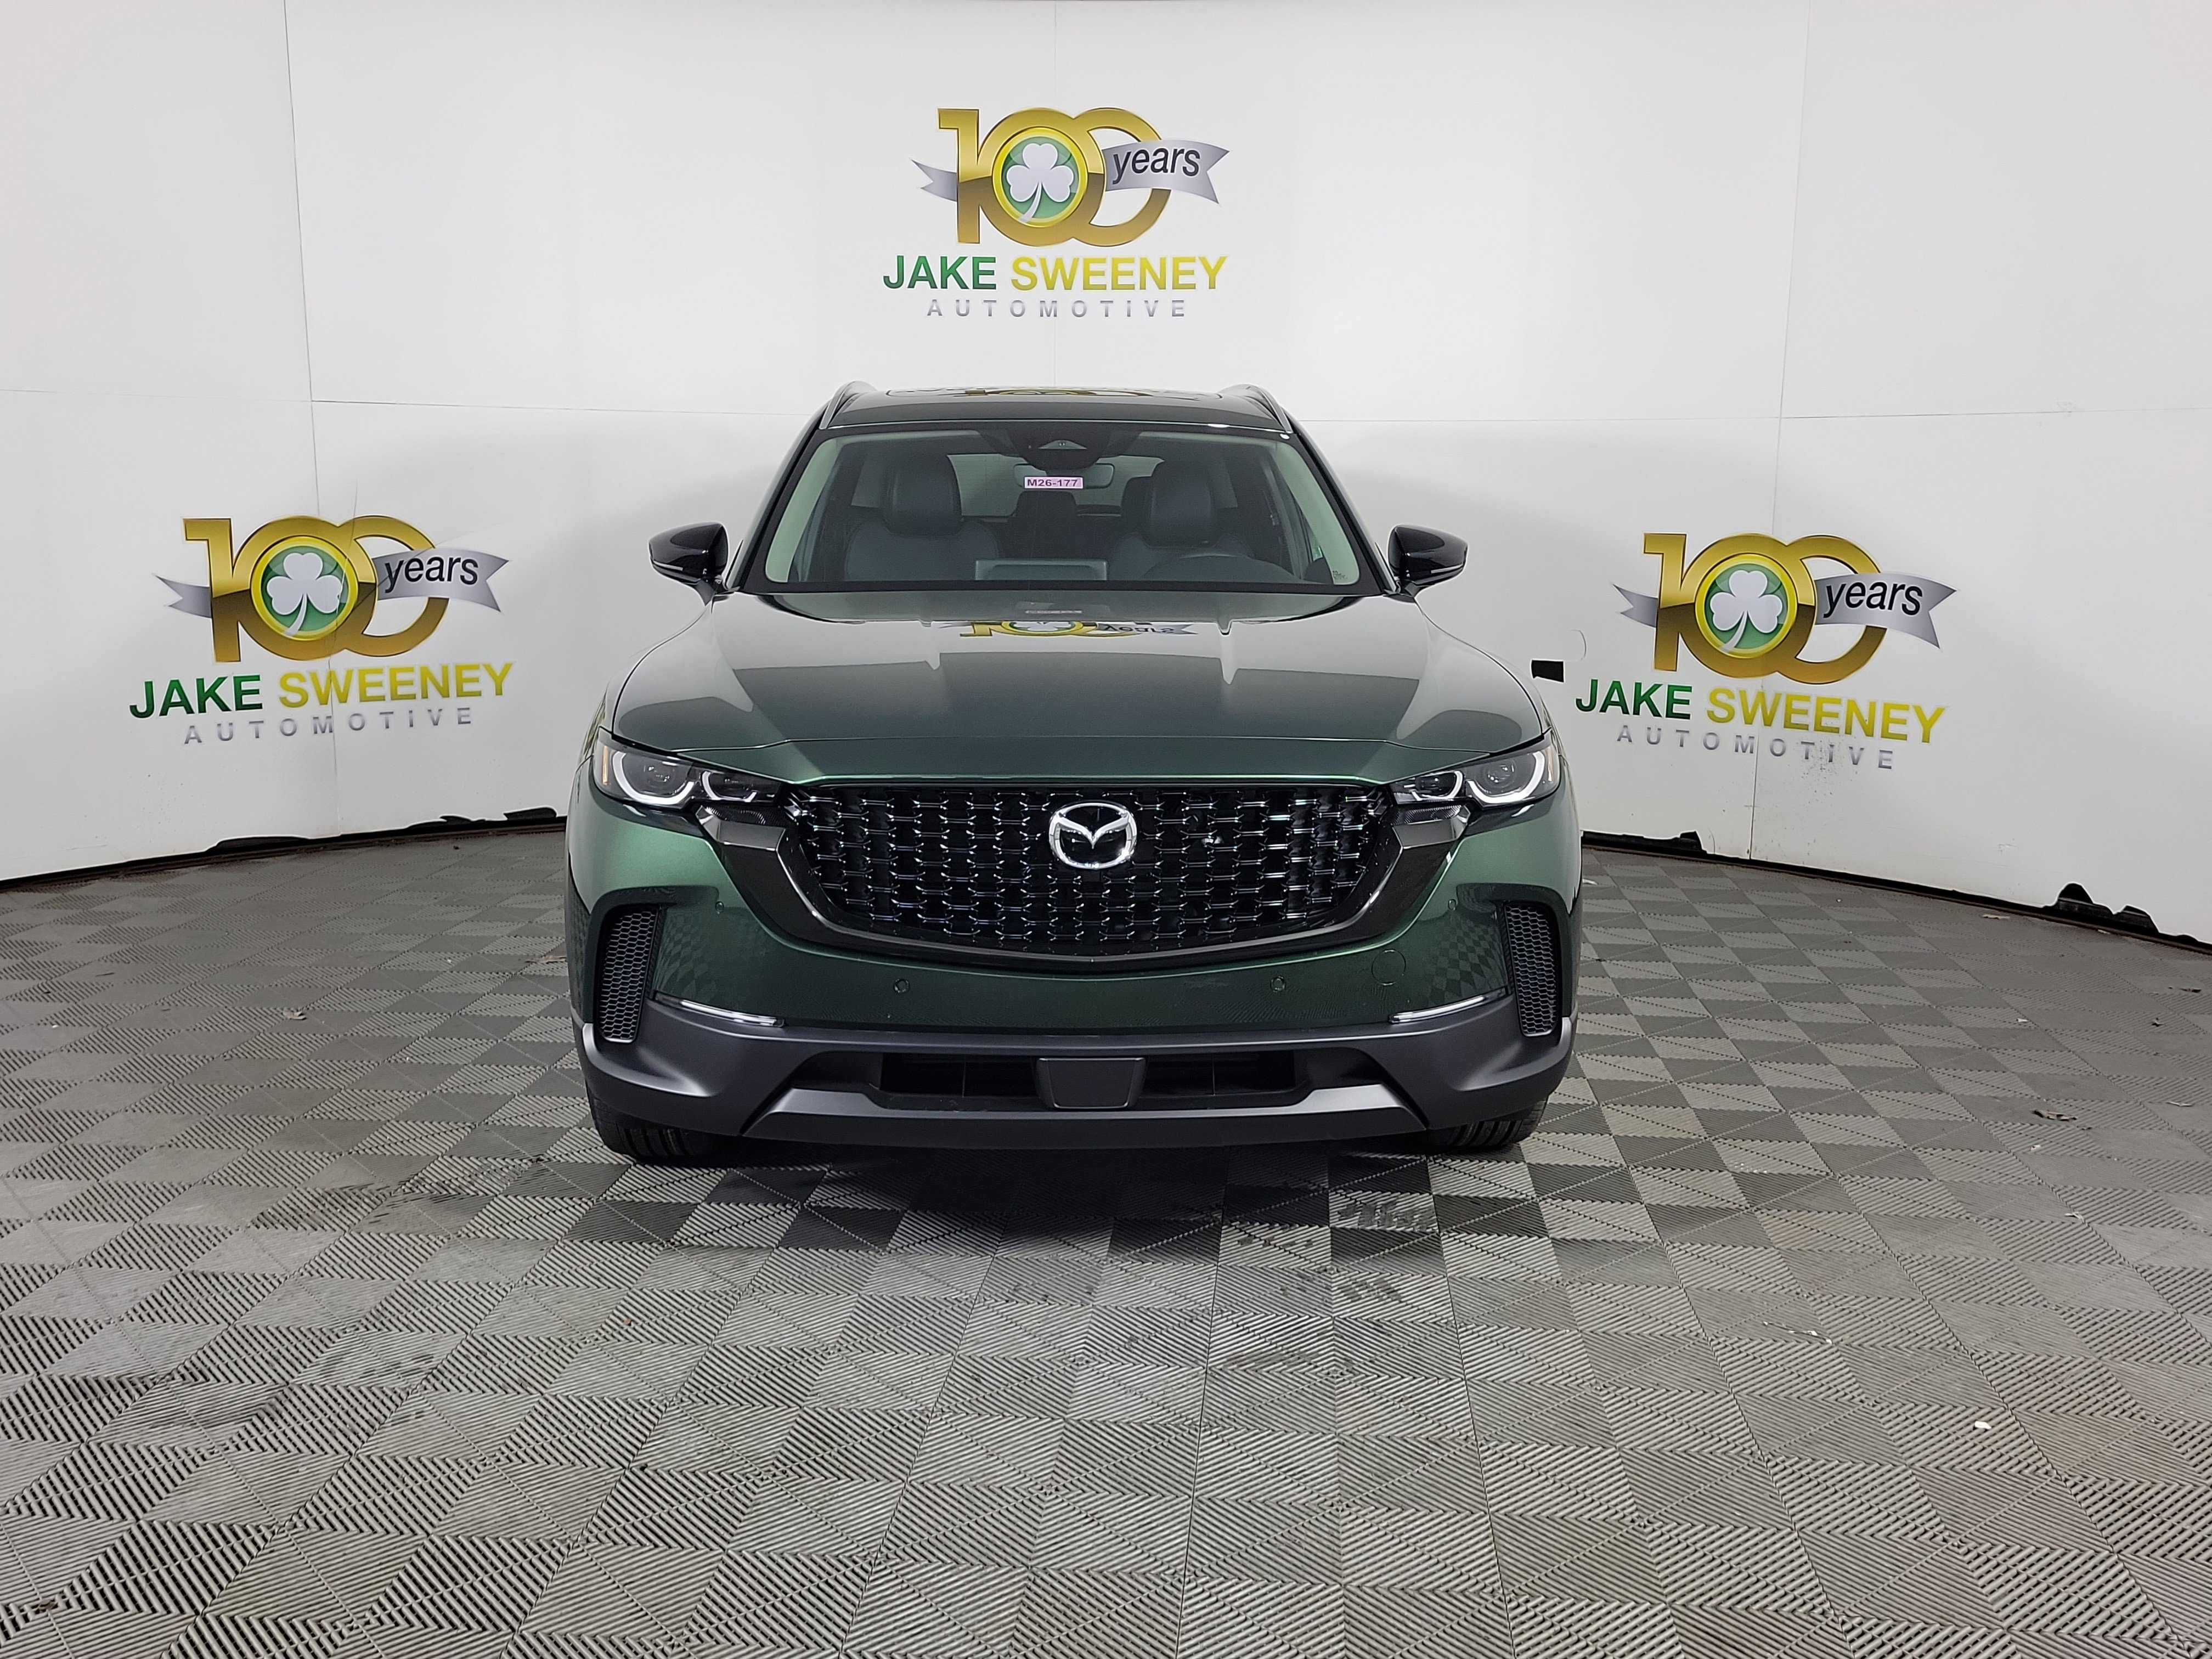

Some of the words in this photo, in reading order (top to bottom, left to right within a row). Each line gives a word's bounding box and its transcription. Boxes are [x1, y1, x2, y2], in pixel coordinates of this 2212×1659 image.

[938, 107, 1171, 247] 100
[1112, 147, 1200, 184] years
[883, 255, 997, 290] JAKE
[1011, 256, 1228, 291] SWEENEY
[927, 299, 1185, 317] AUTOMOTIVE
[182, 516, 449, 662] 100
[385, 556, 479, 593] years
[1644, 533, 1887, 685] 100
[1823, 582, 1923, 618] years
[129, 674, 262, 719] JAKE
[279, 663, 513, 708] SWEENEY
[1575, 679, 1692, 720] JAKE
[1706, 687, 1946, 743] SWEENEY
[184, 707, 472, 744] AUTOMOTIVE
[1617, 725, 1894, 769] AUTOMOTIVE
